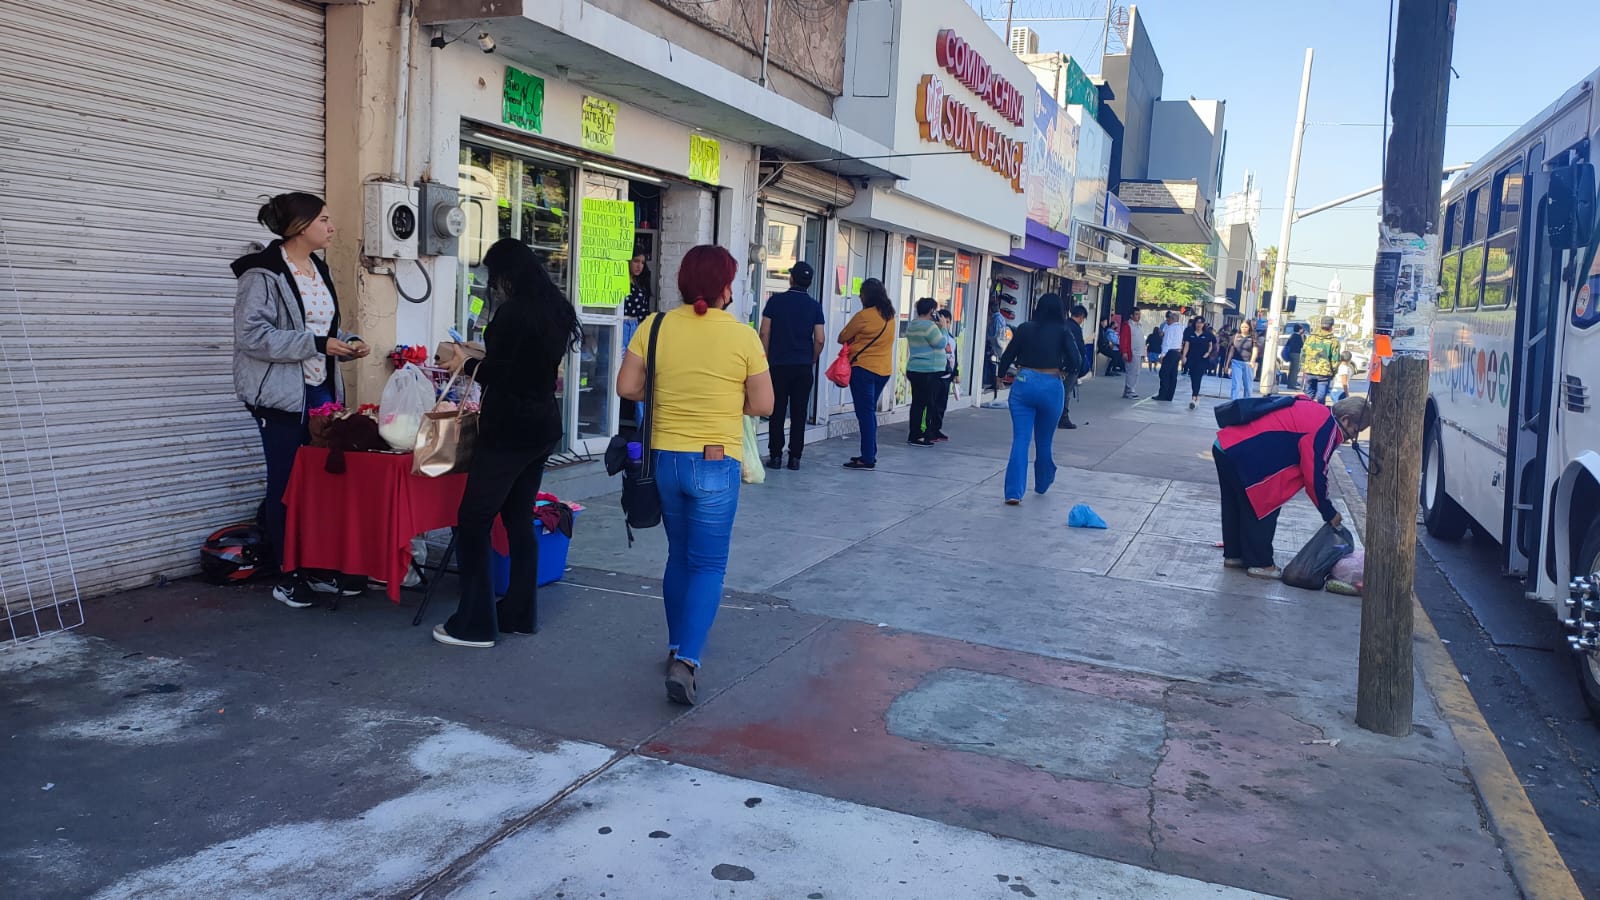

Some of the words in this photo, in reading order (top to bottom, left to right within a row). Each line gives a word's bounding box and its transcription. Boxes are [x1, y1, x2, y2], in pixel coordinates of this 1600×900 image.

[938, 30, 993, 102] COMIDA
[993, 74, 1024, 126] CHINA
[943, 95, 977, 150] SUN
[975, 121, 1020, 180] CHANG
[614, 262, 624, 275] NO
